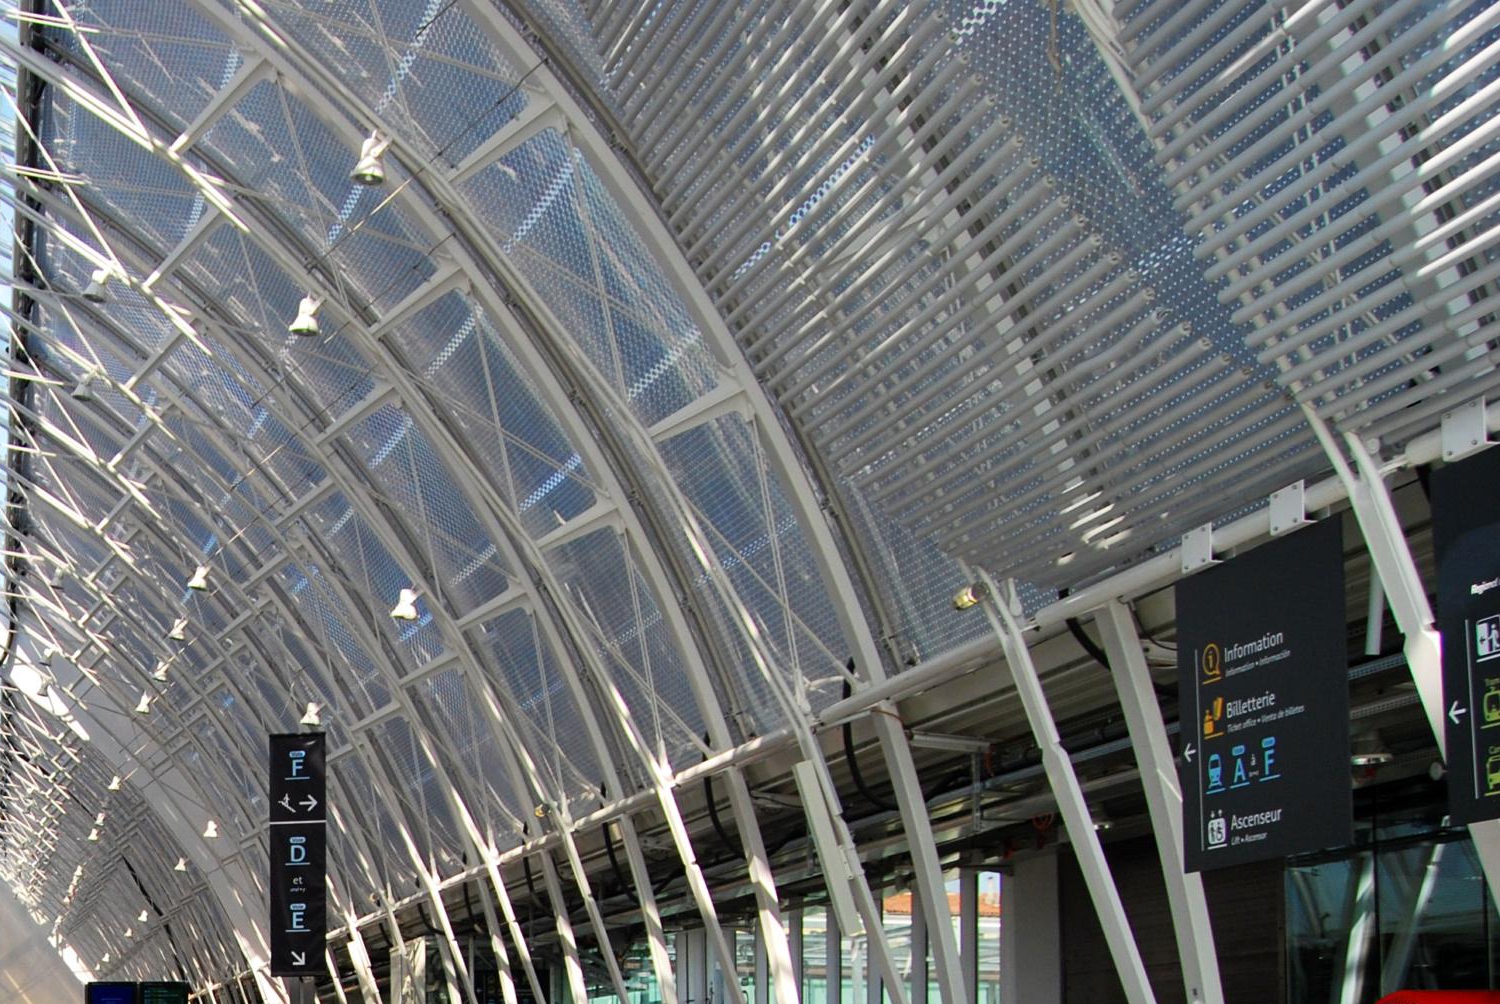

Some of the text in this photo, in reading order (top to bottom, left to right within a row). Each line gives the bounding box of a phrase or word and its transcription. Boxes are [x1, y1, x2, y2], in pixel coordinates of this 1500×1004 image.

[1224, 632, 1284, 664] Information
[1226, 691, 1276, 719] Billetterie
[292, 758, 304, 777] F
[1233, 757, 1247, 784] A
[1264, 748, 1275, 776] F
[1231, 808, 1283, 831] Ascenseur
[290, 844, 306, 863] D
[292, 876, 303, 885] et
[292, 911, 305, 929] E
